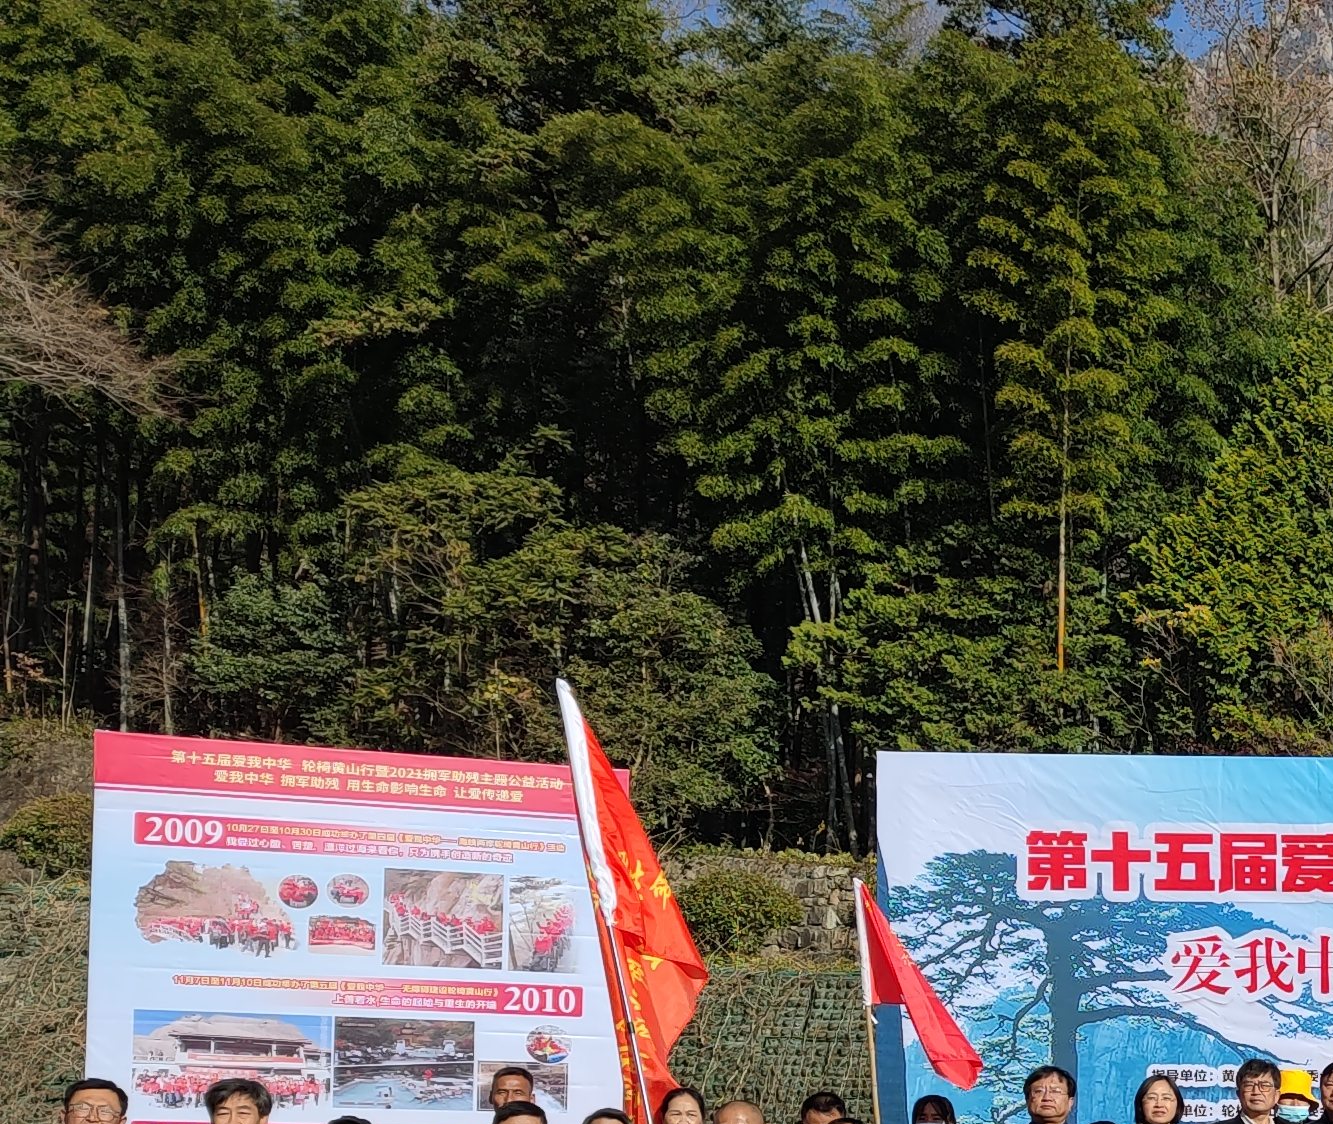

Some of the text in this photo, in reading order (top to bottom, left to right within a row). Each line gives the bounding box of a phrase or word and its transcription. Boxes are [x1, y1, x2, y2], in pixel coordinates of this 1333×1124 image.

[171, 750, 564, 790] 第十五届爱我中华 轮椅黄山行暨2021拥军助残主题公益活动
[213, 770, 524, 803] 爱我中华 拥军助残 用生命影响生命 让爱传递爱
[142, 816, 224, 846] 2009
[503, 986, 576, 1014] 2010
